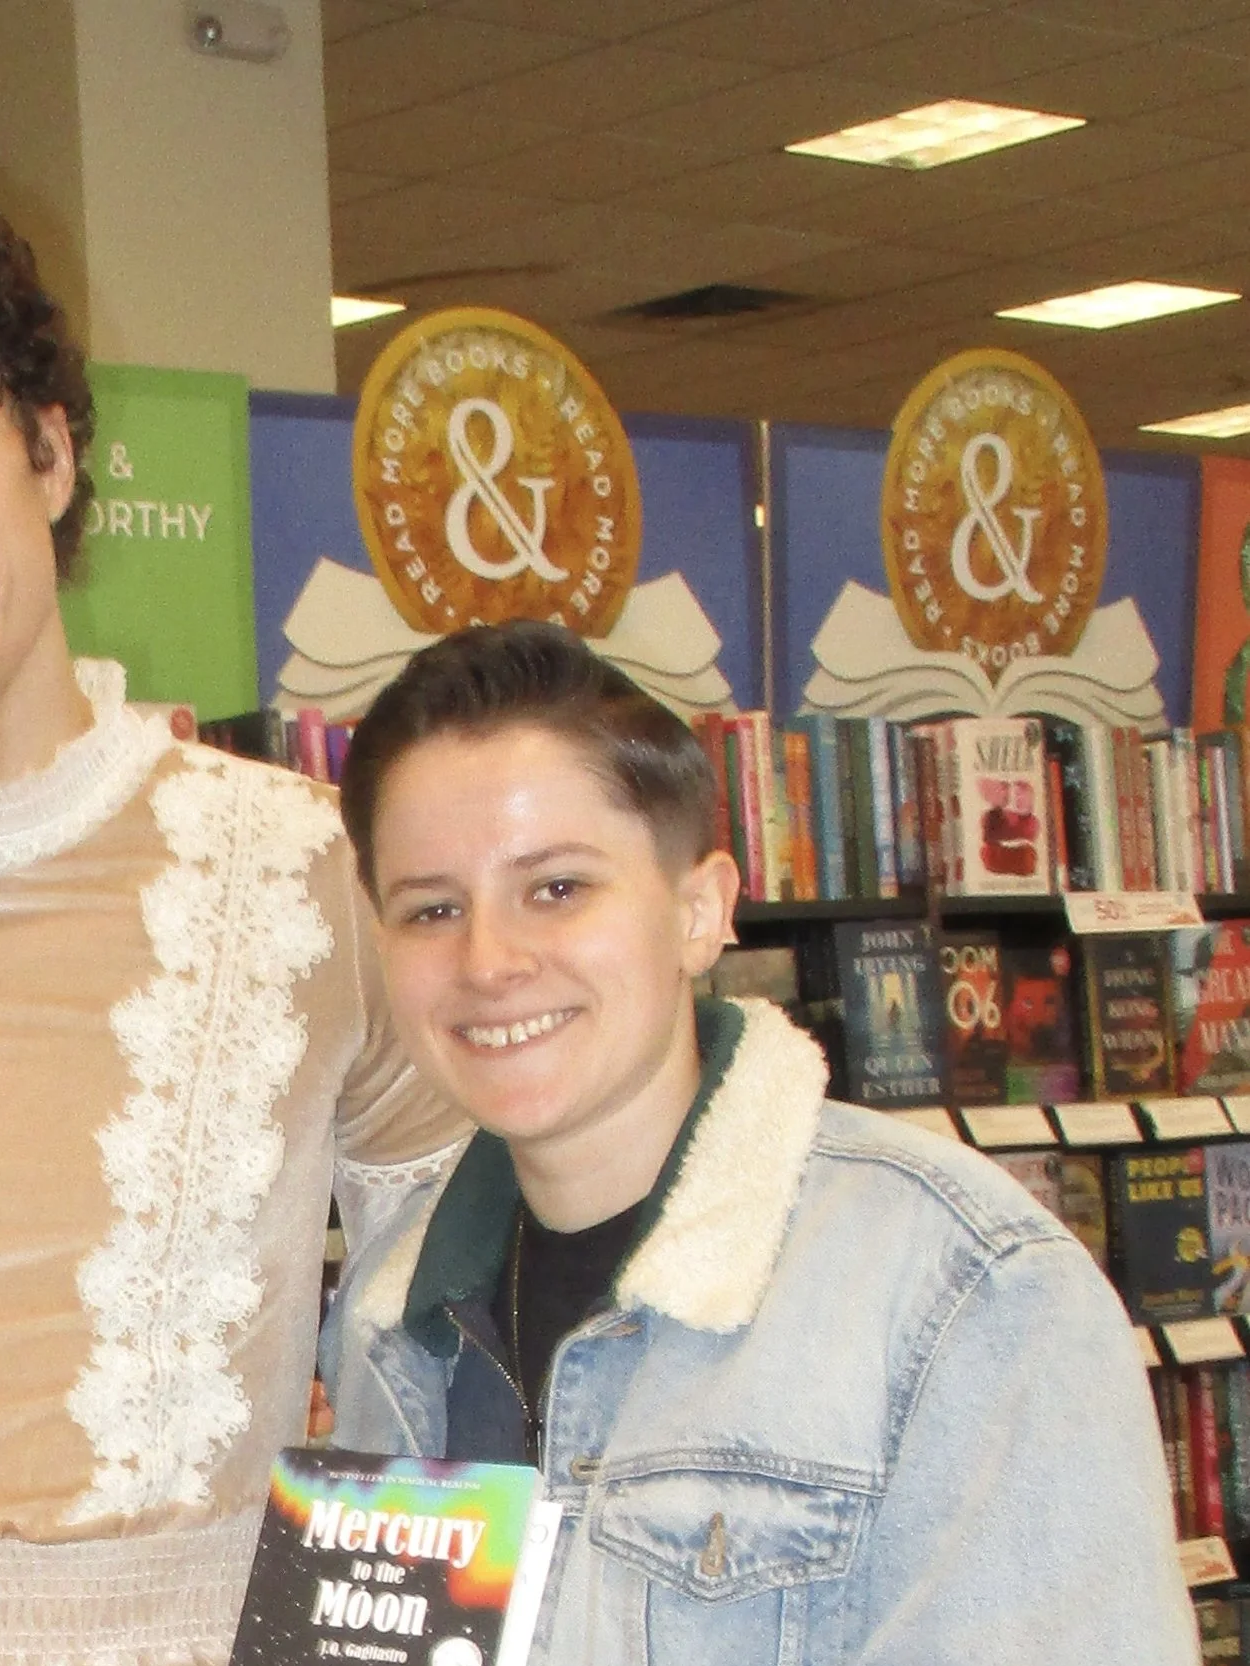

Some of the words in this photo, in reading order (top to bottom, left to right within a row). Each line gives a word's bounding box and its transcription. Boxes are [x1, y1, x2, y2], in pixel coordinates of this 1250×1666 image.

[425, 346, 529, 387] BOOKS
[109, 441, 134, 480] &
[381, 380, 425, 485] MORE
[558, 397, 612, 498] READ
[445, 395, 571, 583] &
[952, 432, 1045, 605] &
[384, 503, 443, 605] READ
[570, 515, 616, 616] MORE
[903, 529, 944, 624] READ
[861, 930, 915, 952] JOHN
[1127, 1154, 1192, 1178] PEOP
[302, 1500, 486, 1569] Mercury
[352, 1559, 373, 1581] to
[374, 1561, 406, 1584] the
[313, 1580, 428, 1636] Moon
